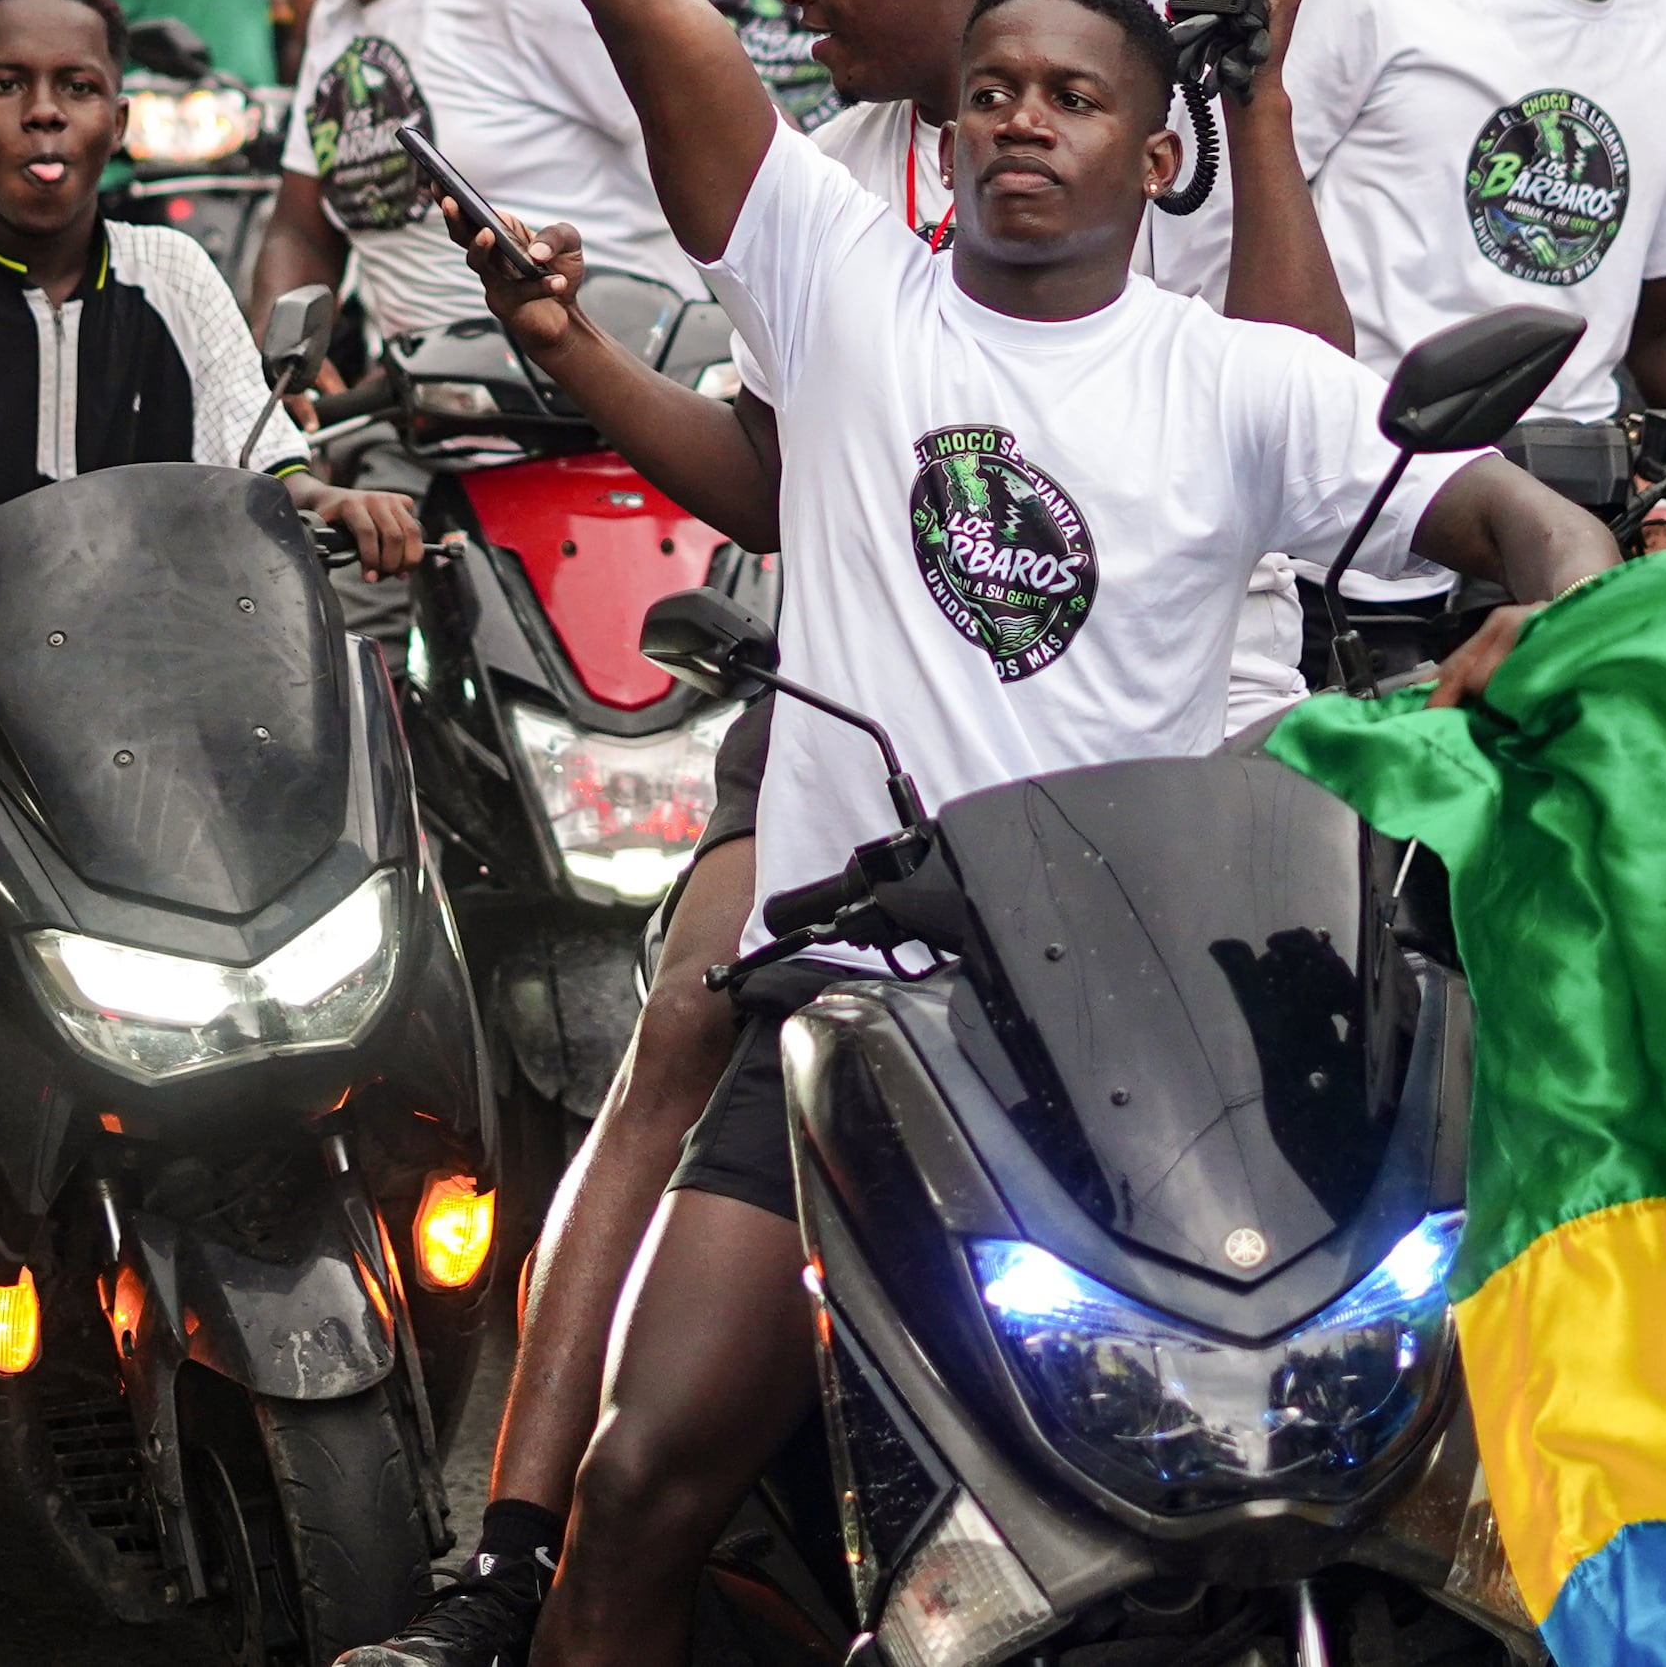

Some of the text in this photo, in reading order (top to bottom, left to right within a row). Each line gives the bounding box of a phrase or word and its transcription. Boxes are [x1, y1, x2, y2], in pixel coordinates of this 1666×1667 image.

[1571, 98, 1590, 117] SE
[1589, 109, 1627, 175] LEVANTA
[1478, 152, 1621, 221] BÁRBAROS
[1531, 158, 1569, 180] LOS
[1504, 200, 1543, 222] AYUDAN
[1543, 210, 1552, 223] A
[1554, 213, 1570, 226] SU
[1473, 215, 1510, 267] UNIDOS
[1512, 263, 1573, 284] SUMOS
[936, 427, 996, 455] HOCÓ
[999, 436, 1022, 462] SE
[947, 512, 995, 539] LOS
[973, 581, 984, 597] A
[985, 583, 1005, 600] SU
[1006, 590, 1048, 610] GENTE
[926, 568, 1063, 670] UNIDOS MÁS
